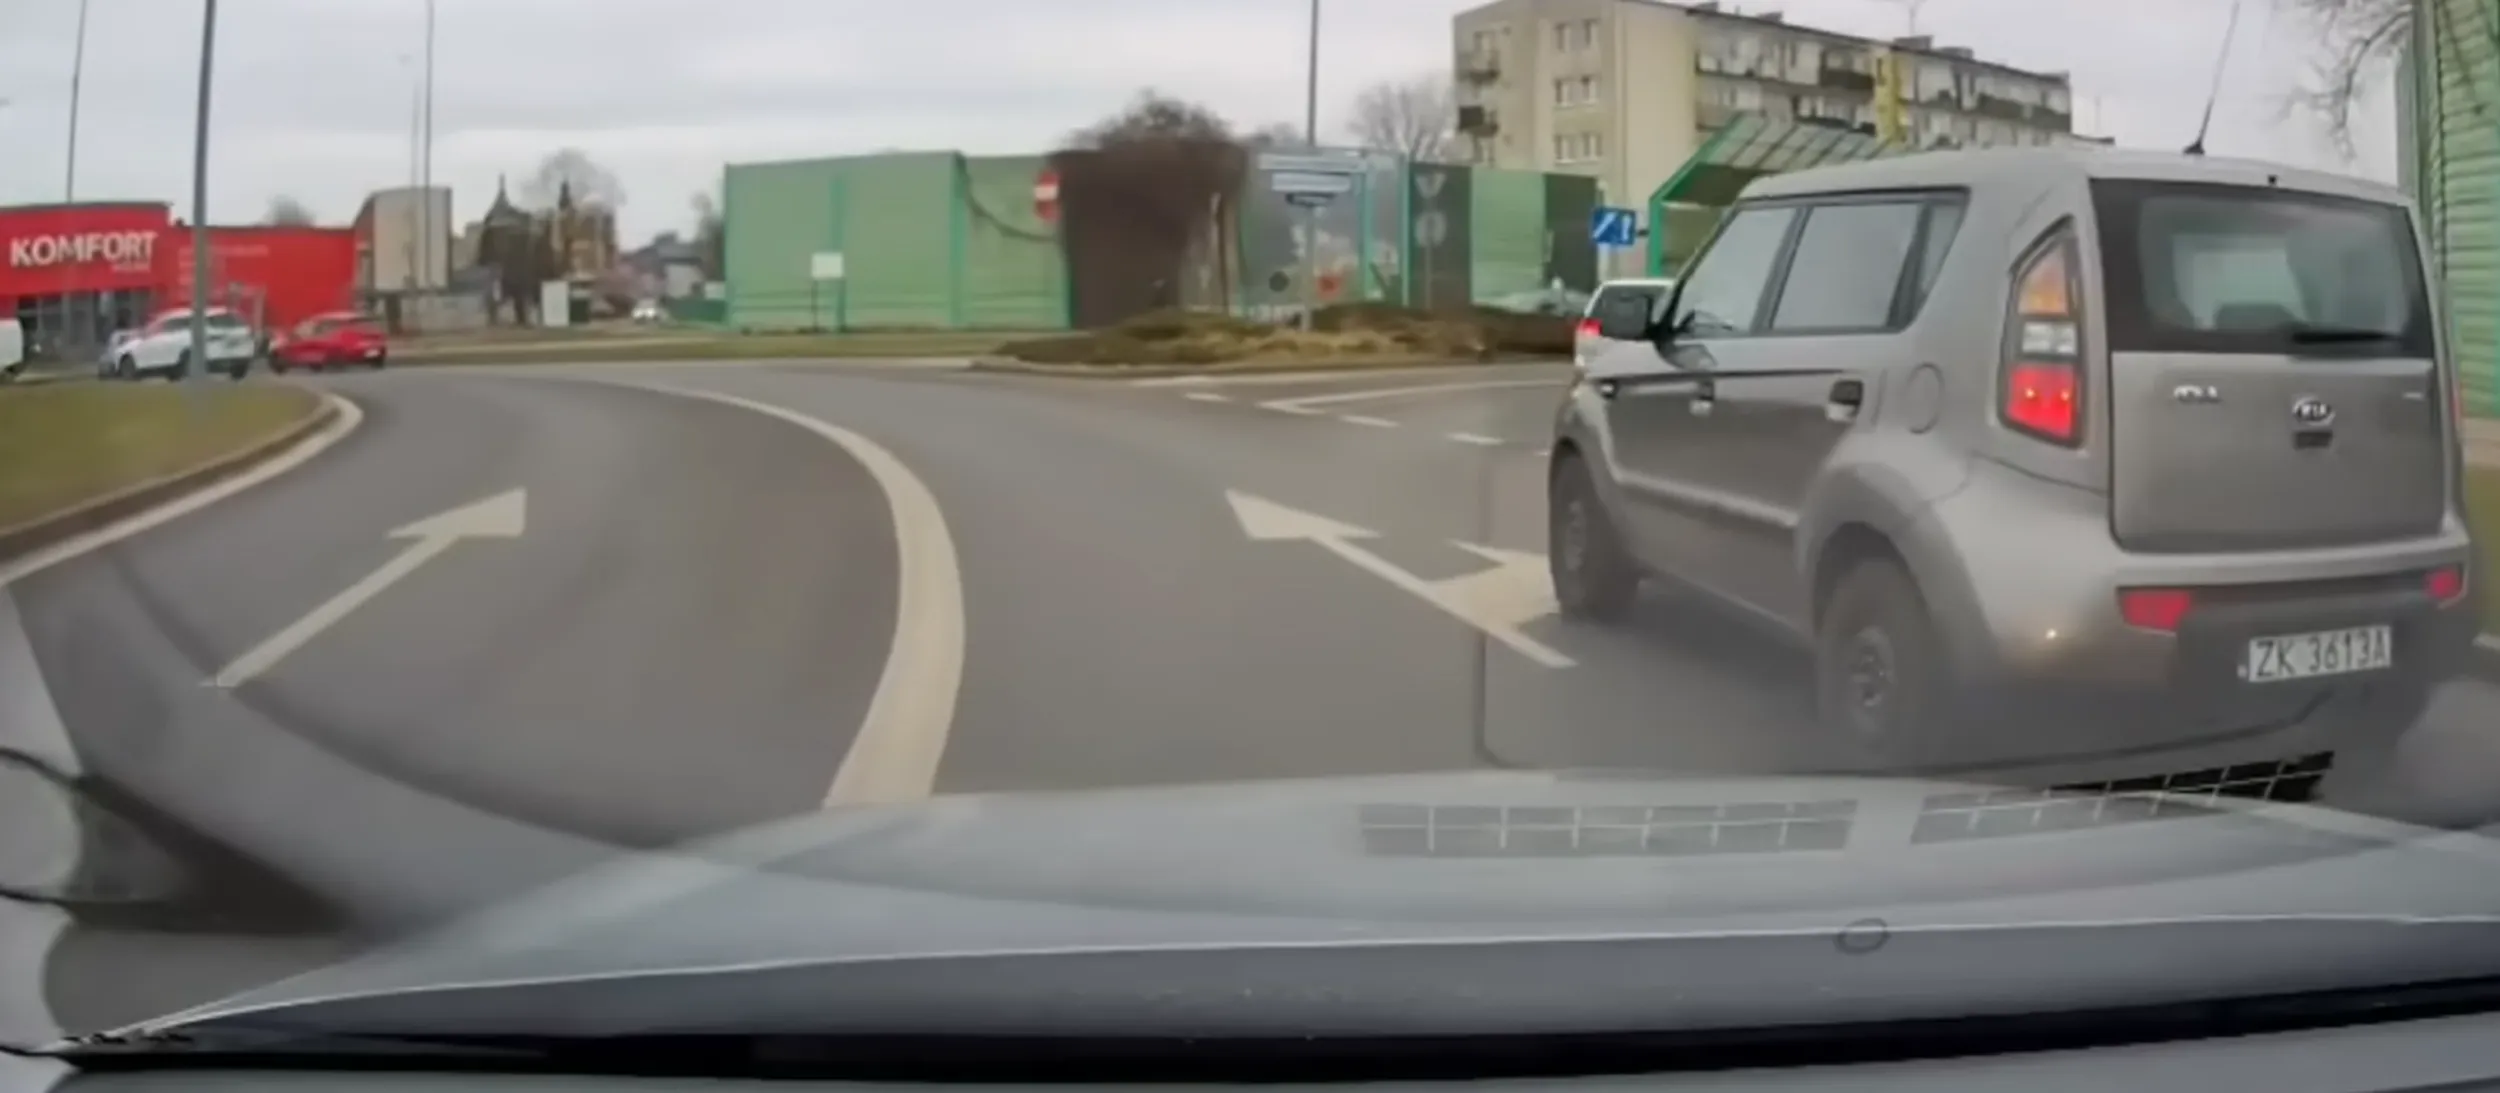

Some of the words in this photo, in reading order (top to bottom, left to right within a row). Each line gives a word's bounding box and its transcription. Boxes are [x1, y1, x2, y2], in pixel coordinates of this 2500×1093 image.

[10, 231, 158, 267] KOMFORT
[2255, 639, 2295, 677] ZK
[2308, 629, 2390, 672] 3613A
